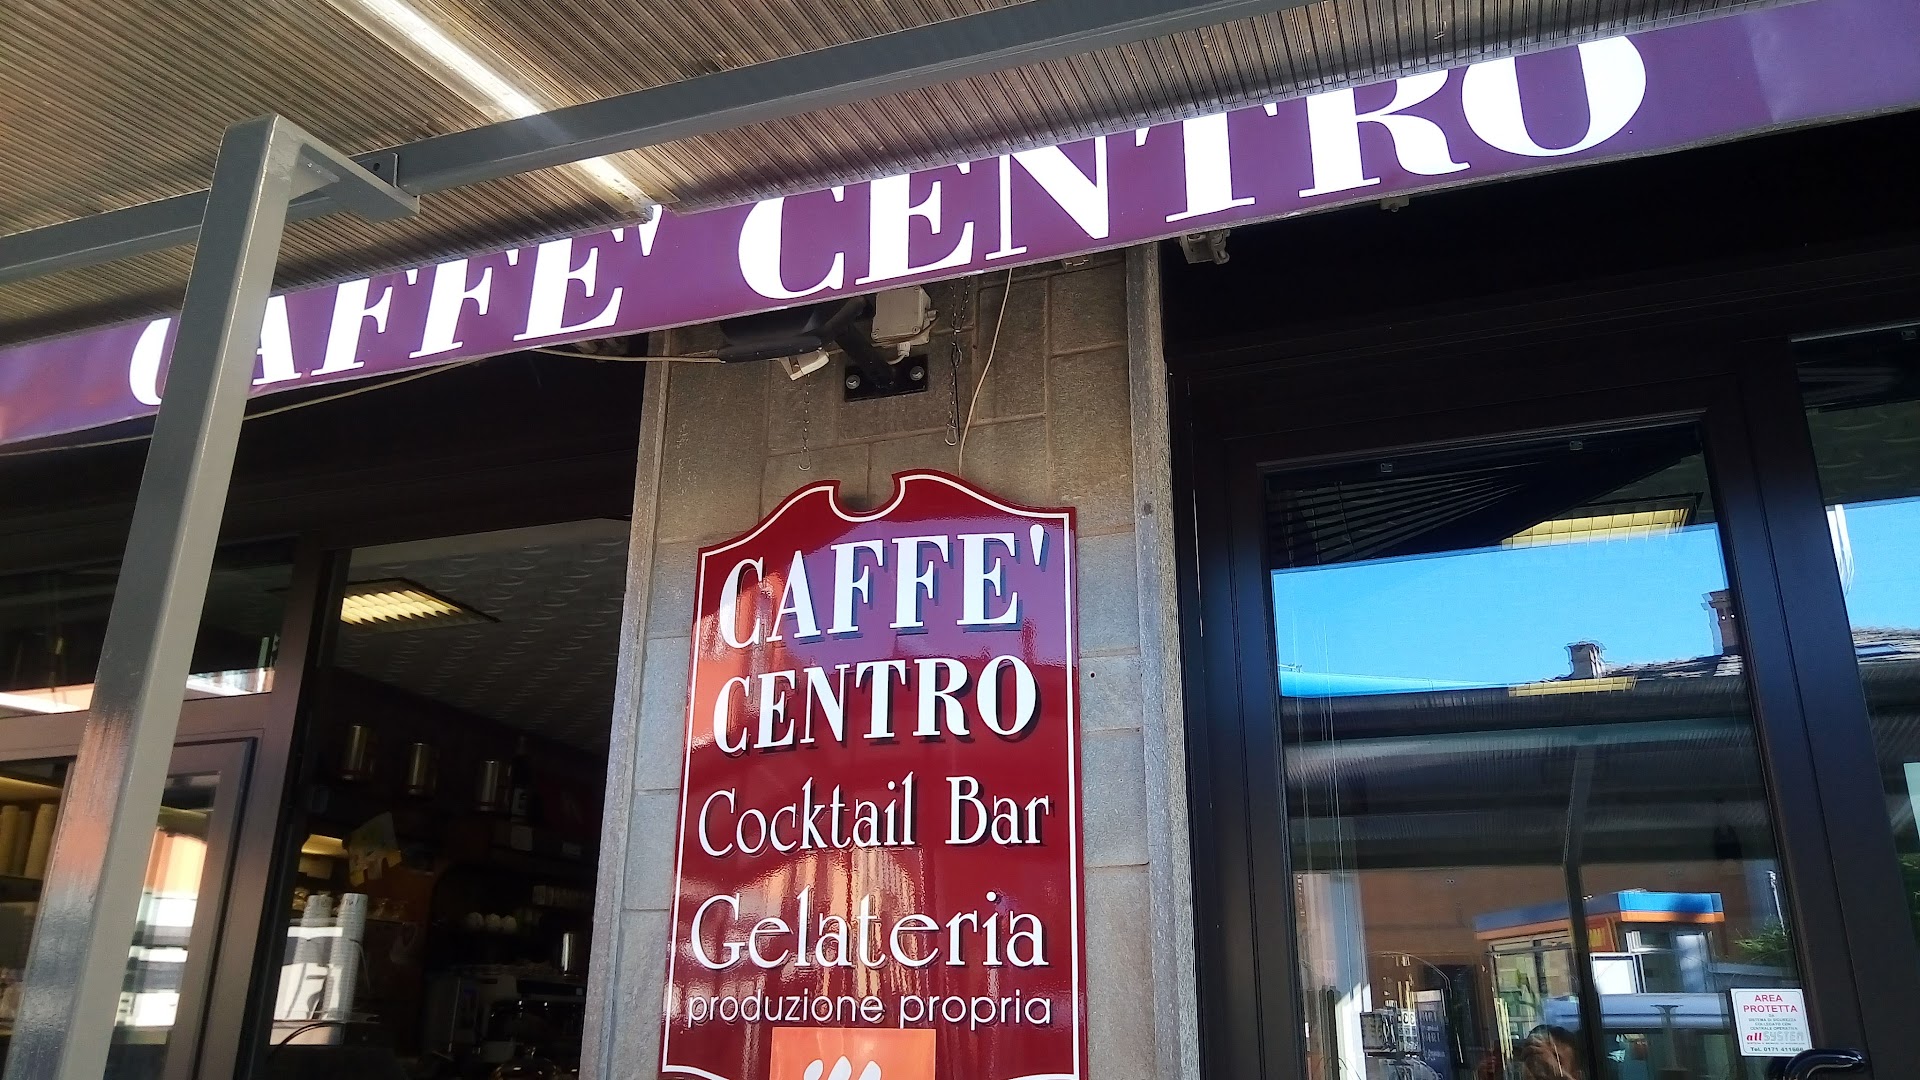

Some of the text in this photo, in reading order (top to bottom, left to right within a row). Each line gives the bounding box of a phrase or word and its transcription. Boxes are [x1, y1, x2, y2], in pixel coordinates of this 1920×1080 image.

[738, 35, 1647, 299] CENTRO
[718, 523, 1046, 650] CAFFE'
[712, 654, 1038, 754] CENTRO
[697, 770, 1051, 857] Cocktail Bar
[690, 884, 1051, 970] Gelateria
[686, 988, 1053, 1031] produzione propria
[1743, 1005, 1798, 1013] PROTETTA
[1754, 994, 1783, 1002] AREA
